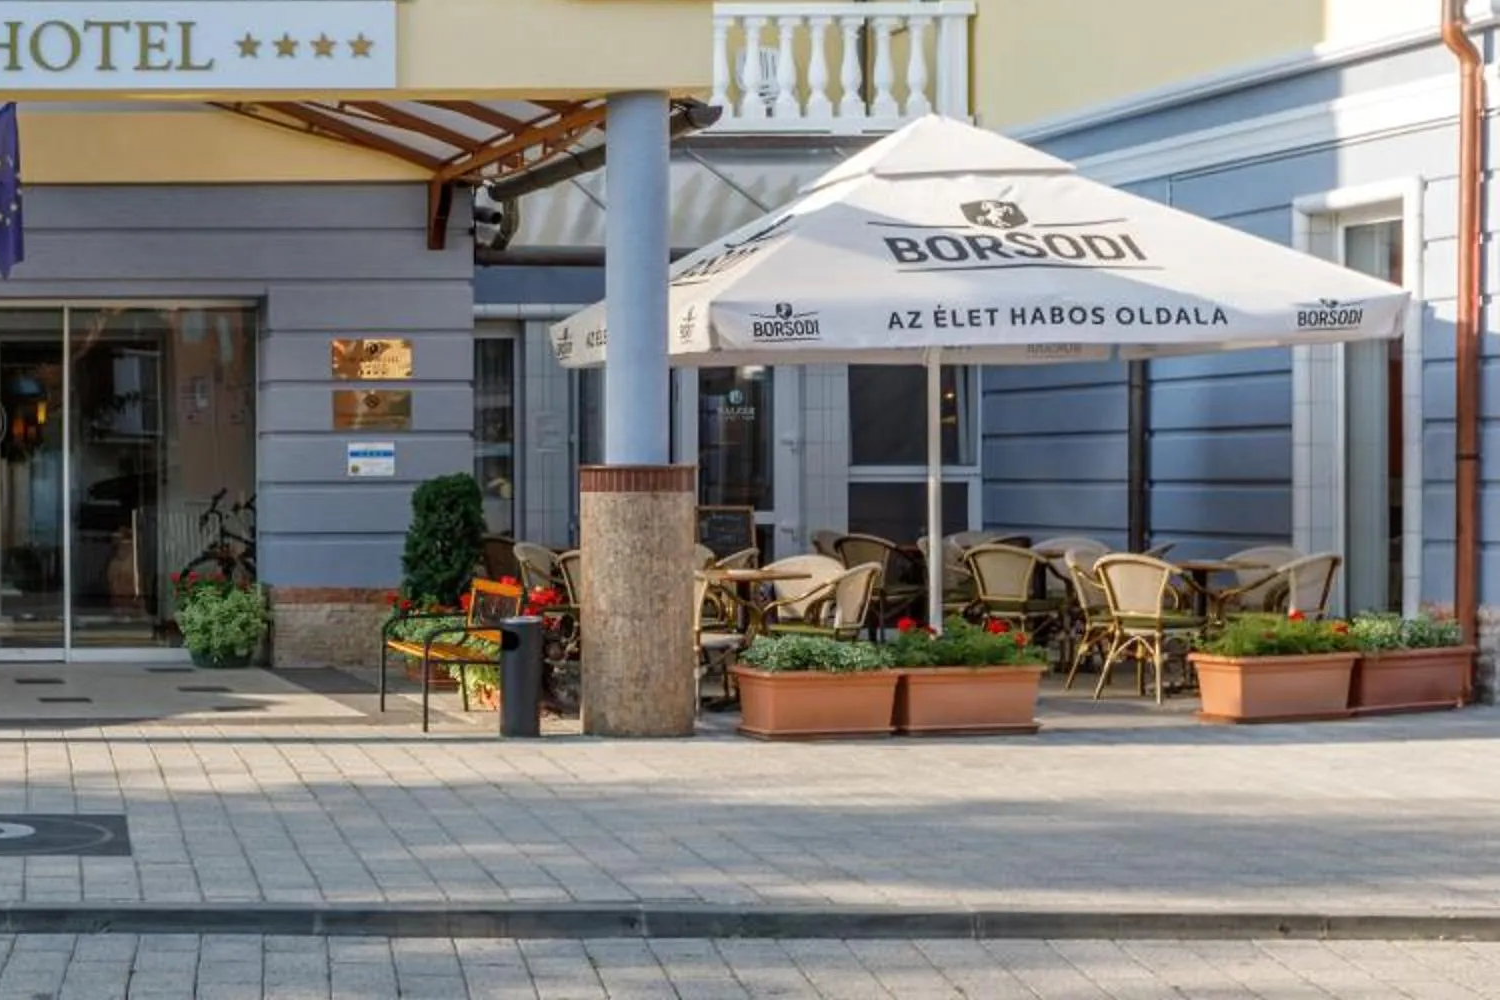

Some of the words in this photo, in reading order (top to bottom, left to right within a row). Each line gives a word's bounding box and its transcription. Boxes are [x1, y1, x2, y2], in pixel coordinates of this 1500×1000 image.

[884, 231, 1148, 264] BORSODI
[888, 311, 923, 330] AZ
[933, 304, 1000, 329] ÉLET
[1010, 306, 1106, 327] HABOS
[1115, 306, 1229, 326] OLDALA
[1296, 309, 1363, 328] BORSODI
[752, 319, 821, 338] BORSODI
